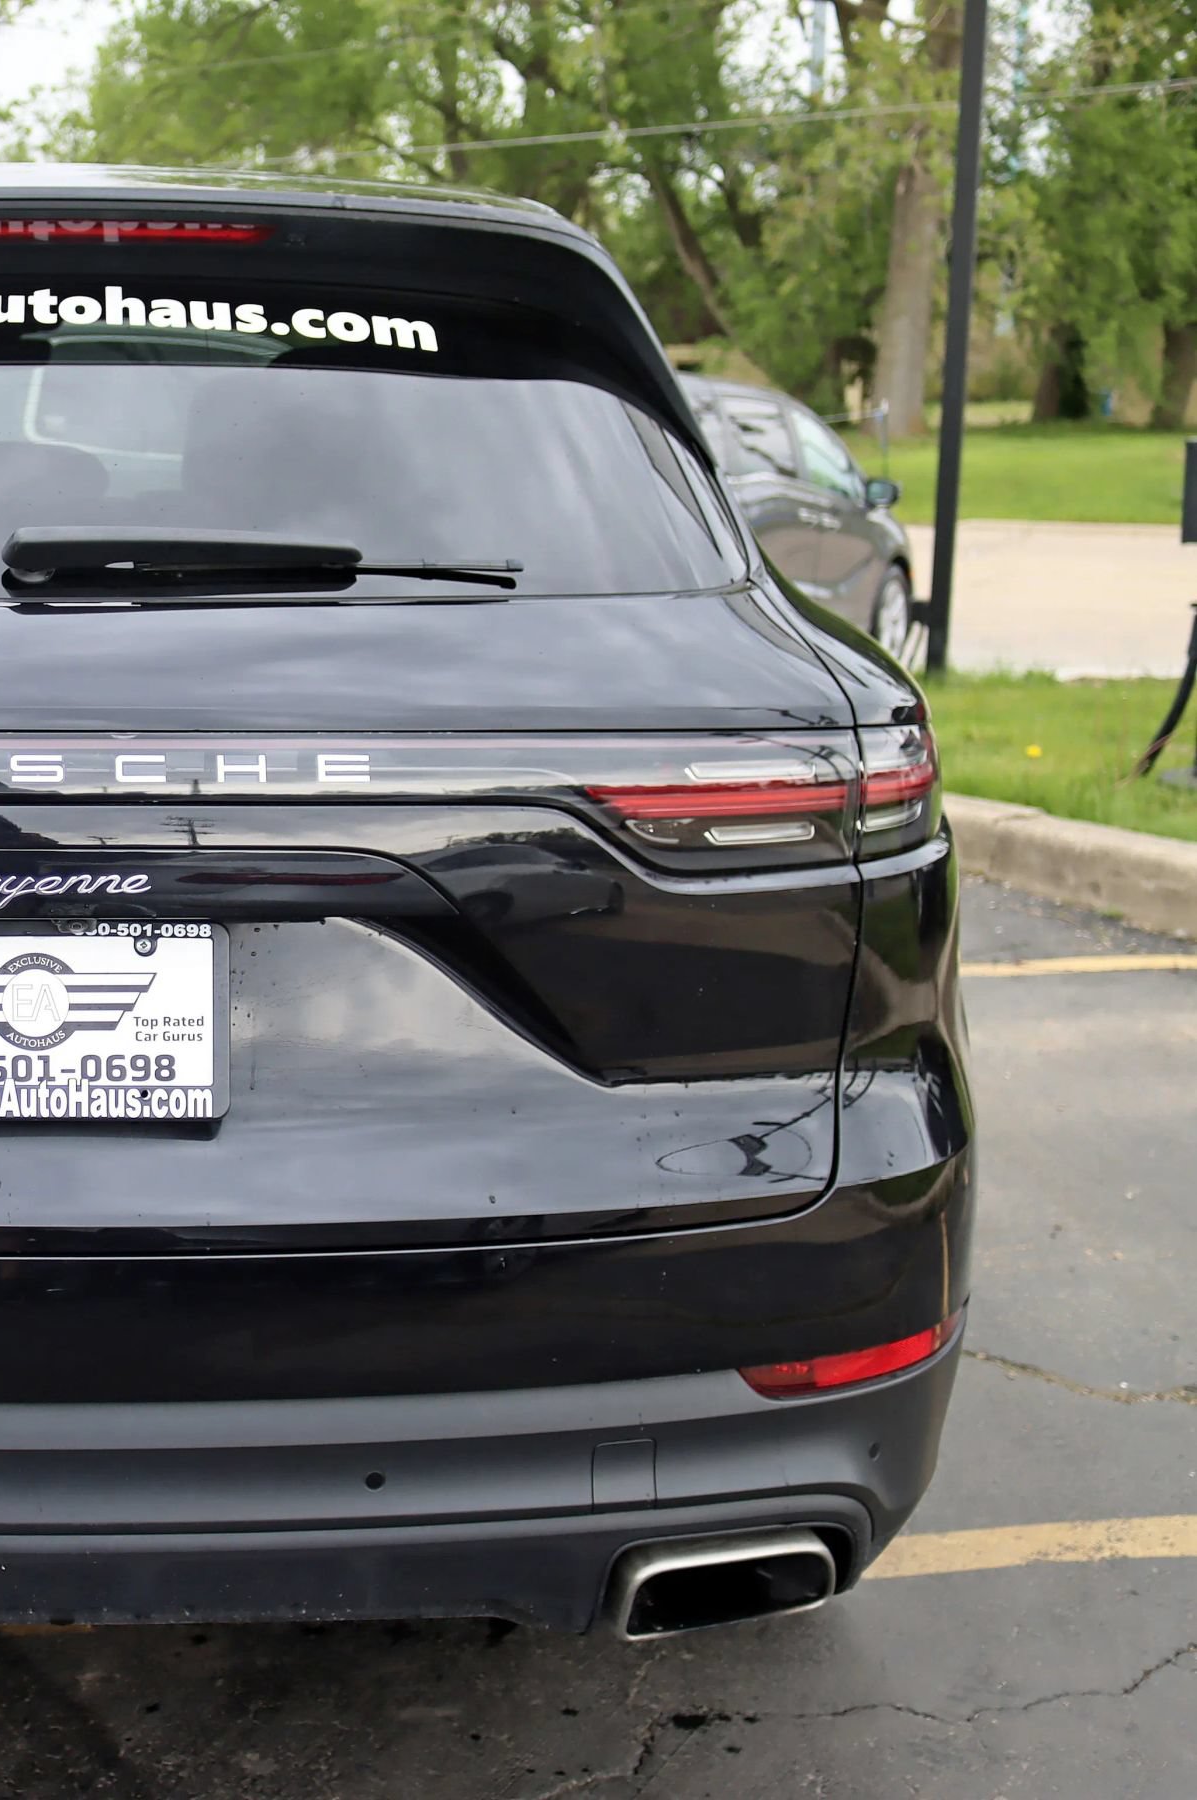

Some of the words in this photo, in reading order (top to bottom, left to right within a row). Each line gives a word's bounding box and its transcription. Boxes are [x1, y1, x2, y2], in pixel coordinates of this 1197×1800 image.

[73, 922, 212, 938] 0-501-0698
[7, 956, 63, 974] EXCLUSIVE
[11, 983, 61, 1022] EA
[133, 1016, 158, 1030] Top
[163, 1015, 204, 1027] Rated
[6, 1030, 66, 1048] AUTOHAUS
[135, 1031, 159, 1042] Car
[162, 1031, 203, 1042] Gurus
